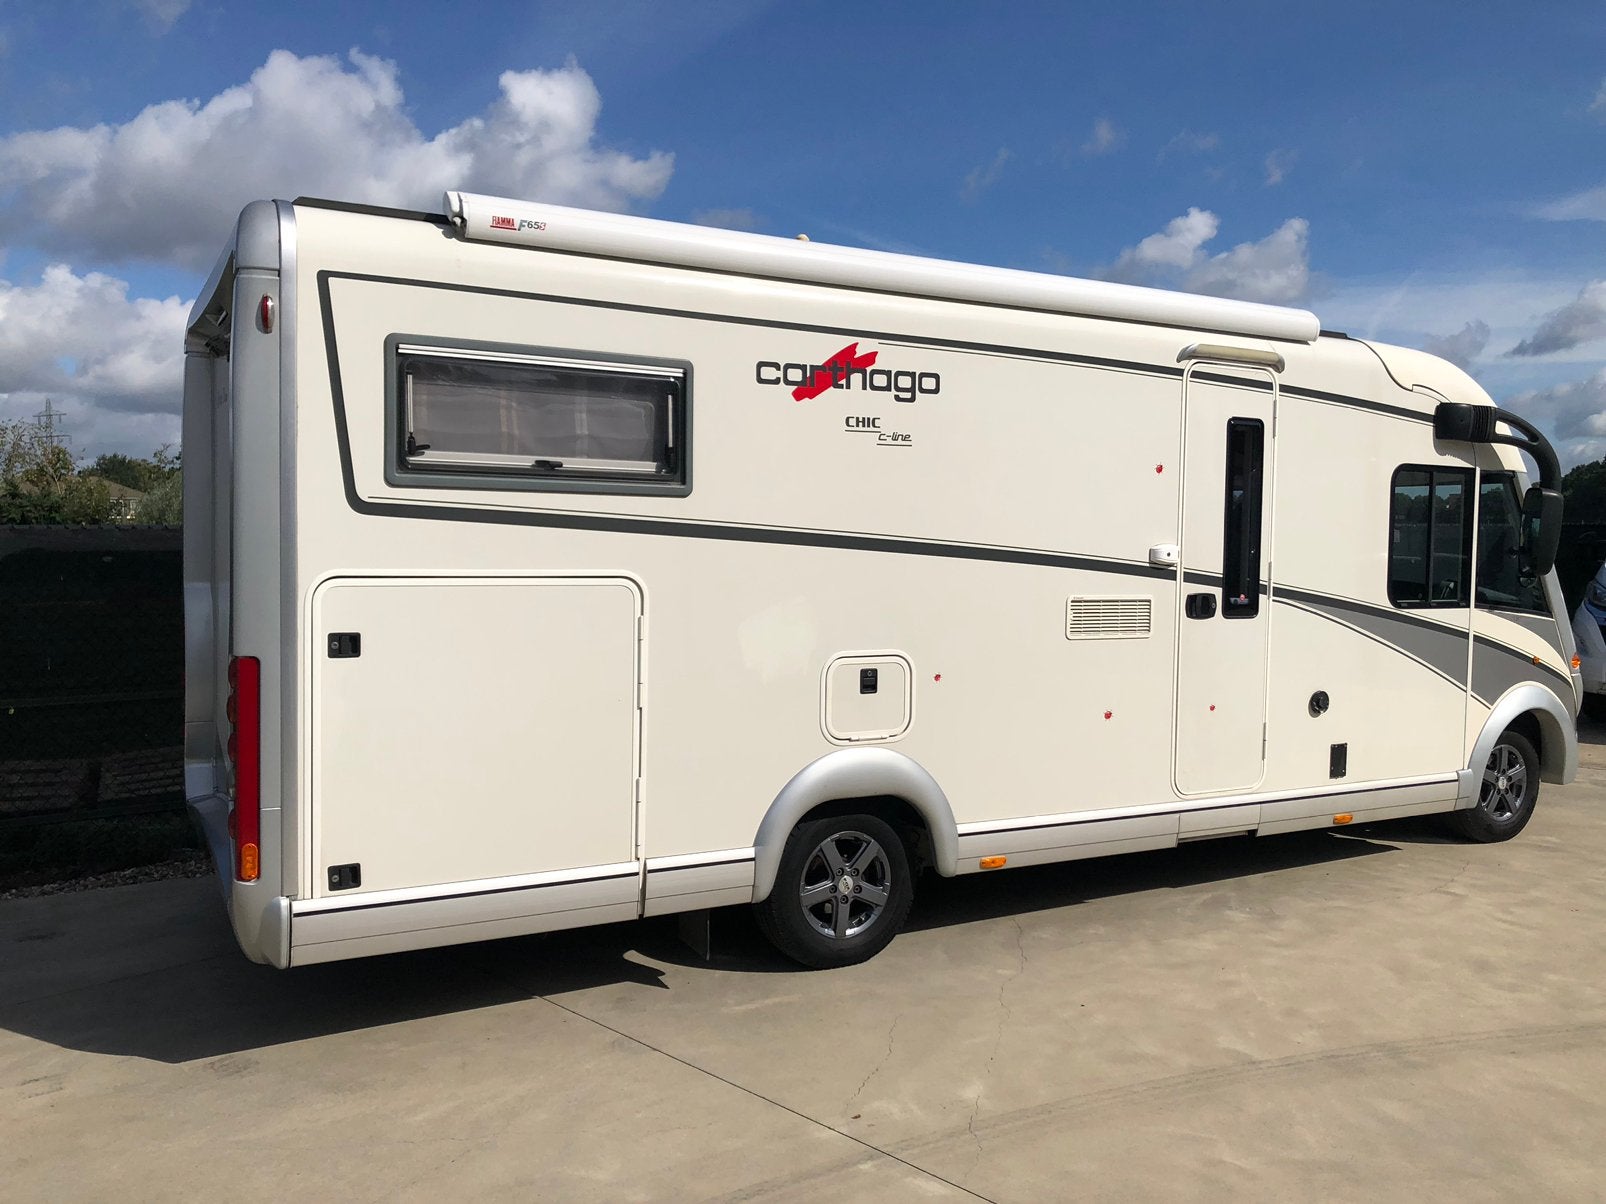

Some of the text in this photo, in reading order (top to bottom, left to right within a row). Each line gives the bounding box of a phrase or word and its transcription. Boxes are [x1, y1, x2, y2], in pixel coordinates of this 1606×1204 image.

[492, 216, 515, 227] FIAMMA
[756, 360, 941, 403] carthago
[845, 416, 881, 429] CHIC
[878, 431, 912, 442] c-line
